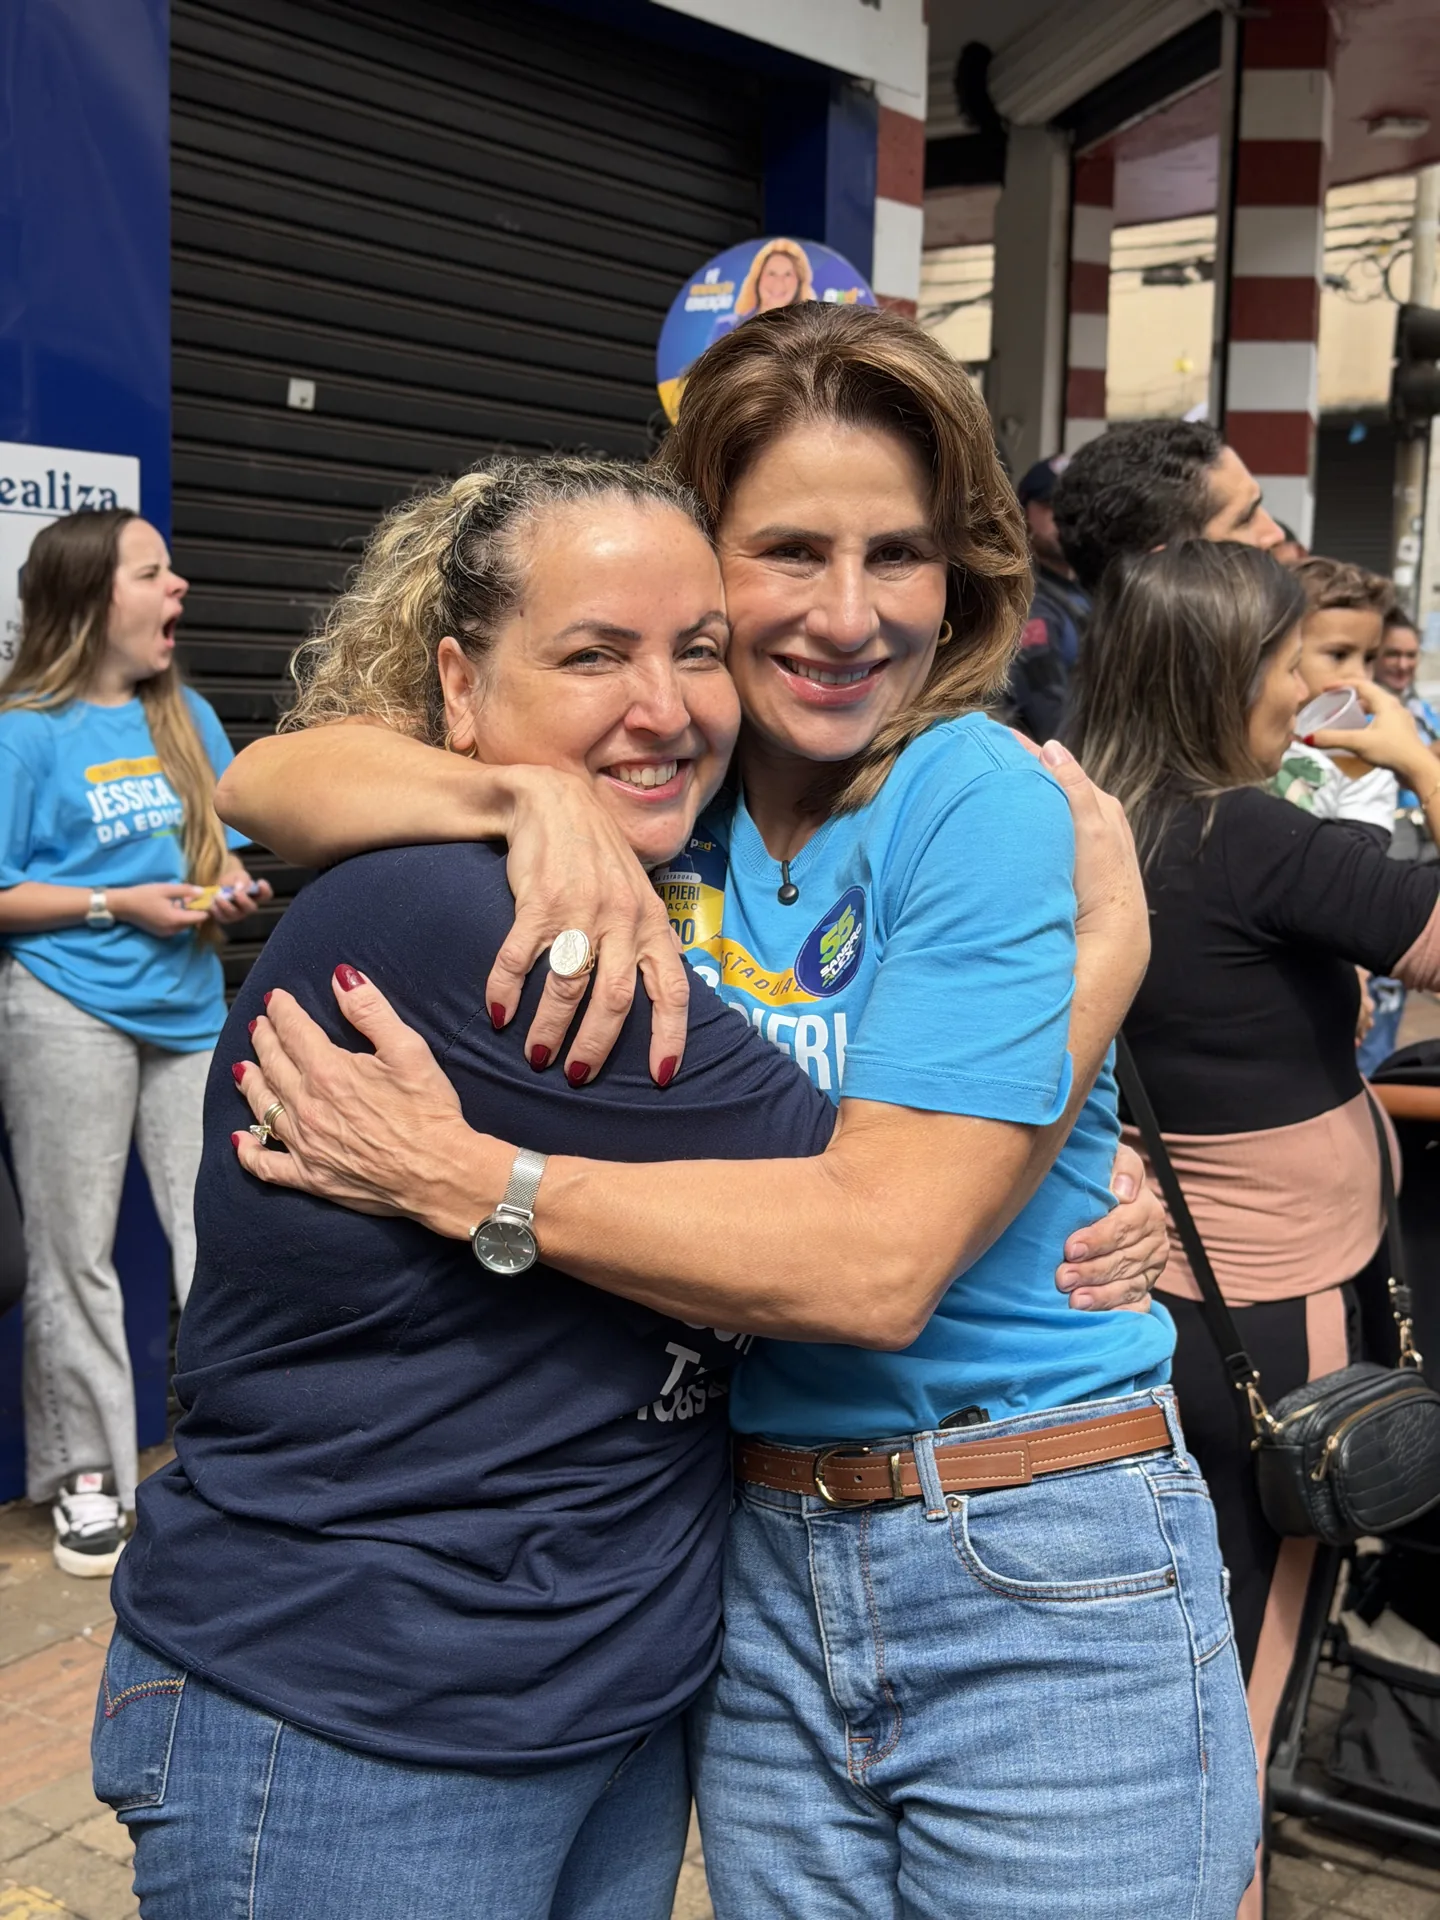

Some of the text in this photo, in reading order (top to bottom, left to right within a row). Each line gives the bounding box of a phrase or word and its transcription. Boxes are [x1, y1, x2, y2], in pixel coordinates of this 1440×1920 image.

[96, 820, 130, 843] DA
[690, 838, 712, 852] psd
[669, 885, 701, 901] PIERI
[819, 904, 855, 964] 55
[820, 923, 862, 977] SANDRO
